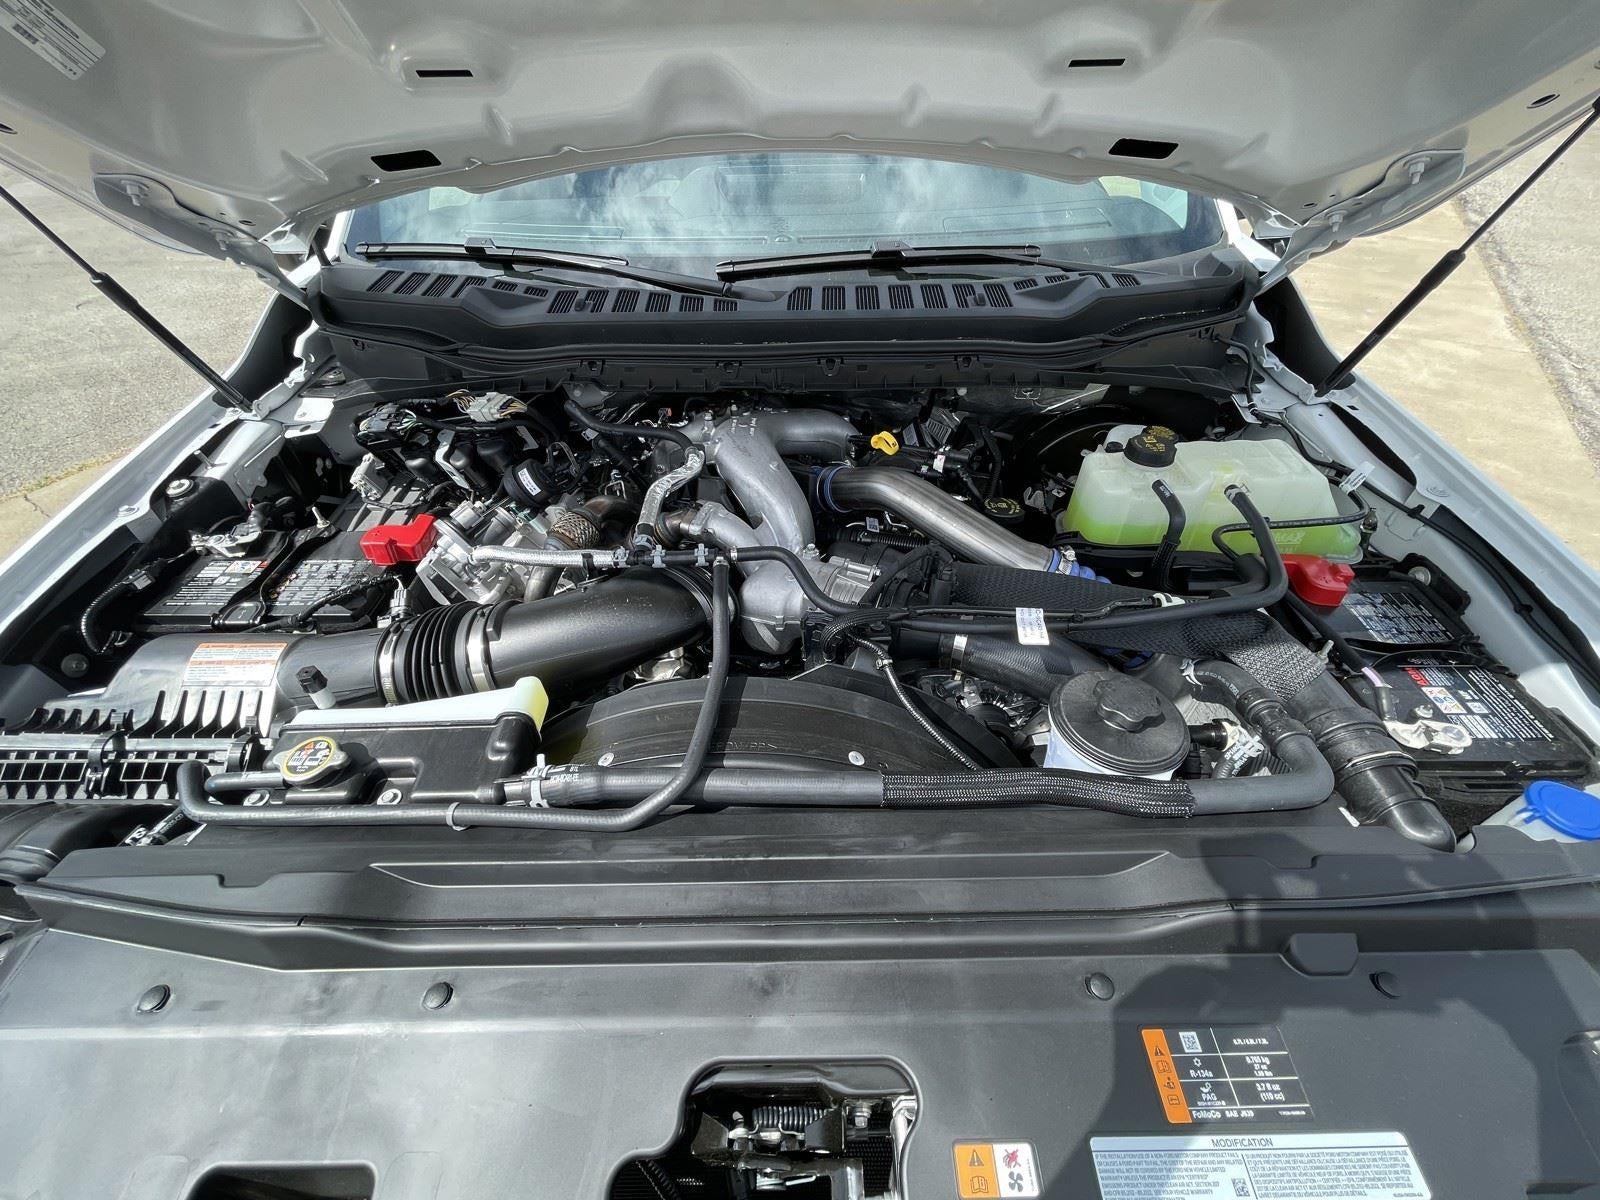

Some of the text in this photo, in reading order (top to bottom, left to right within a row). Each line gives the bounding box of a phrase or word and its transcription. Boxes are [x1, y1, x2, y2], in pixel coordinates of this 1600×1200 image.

[1190, 1070, 1213, 1078] R-134a
[1202, 1093, 1218, 1101] PAG
[1192, 1110, 1222, 1118] FoMoCo
[1211, 1138, 1274, 1148] MODIFICATION
